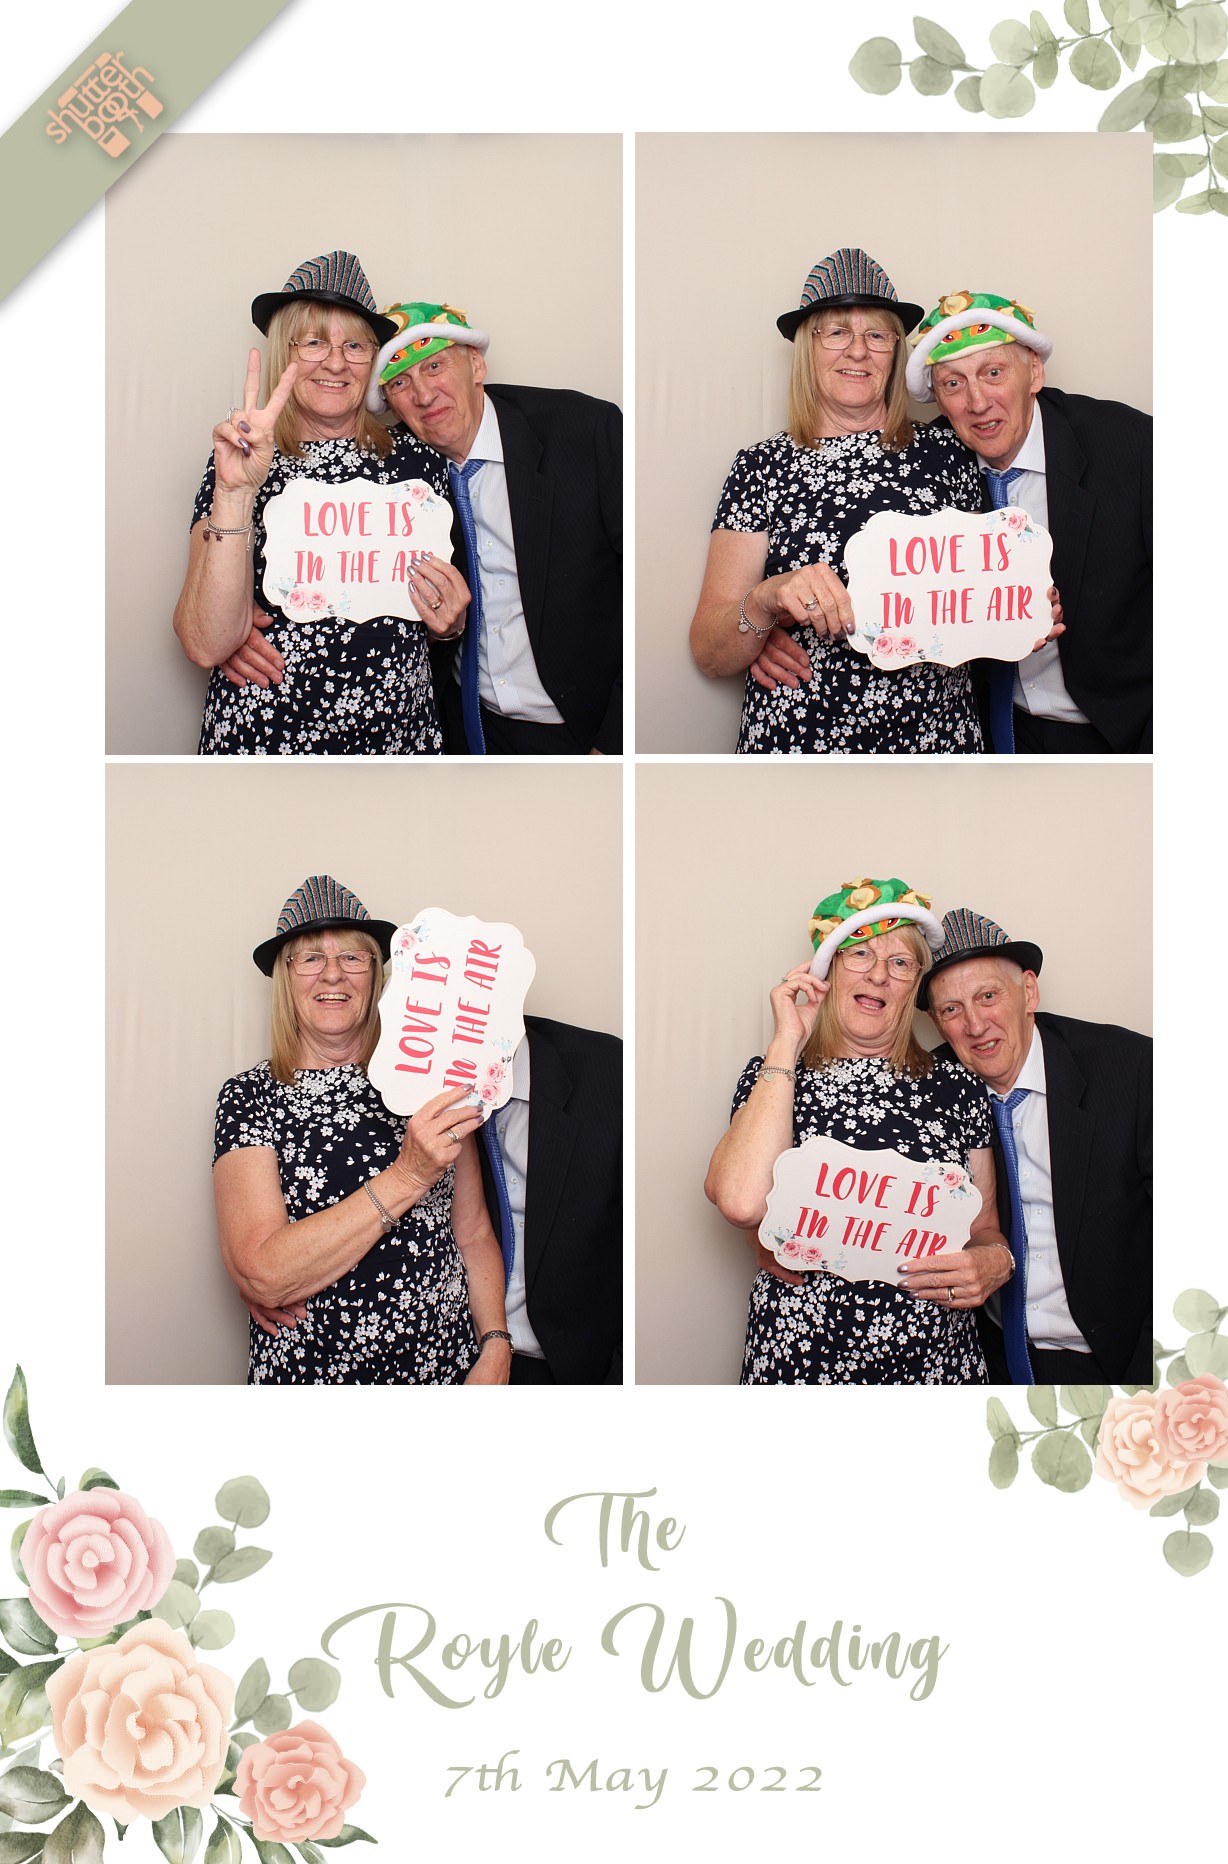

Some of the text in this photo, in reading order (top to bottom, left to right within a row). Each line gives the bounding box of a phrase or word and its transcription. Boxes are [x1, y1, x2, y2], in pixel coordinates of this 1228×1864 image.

[303, 501, 416, 537] LOVE IS
[337, 550, 381, 584] THE
[889, 532, 1012, 577] LOVE IS
[927, 587, 975, 626] THE
[986, 585, 1033, 622] AIR
[463, 939, 502, 991] AIR
[394, 951, 451, 1075] LOVE IS
[451, 996, 491, 1045] THE
[814, 1162, 941, 1218] LOVE IS
[841, 1215, 892, 1252] THE
[894, 1228, 947, 1260] AIR
